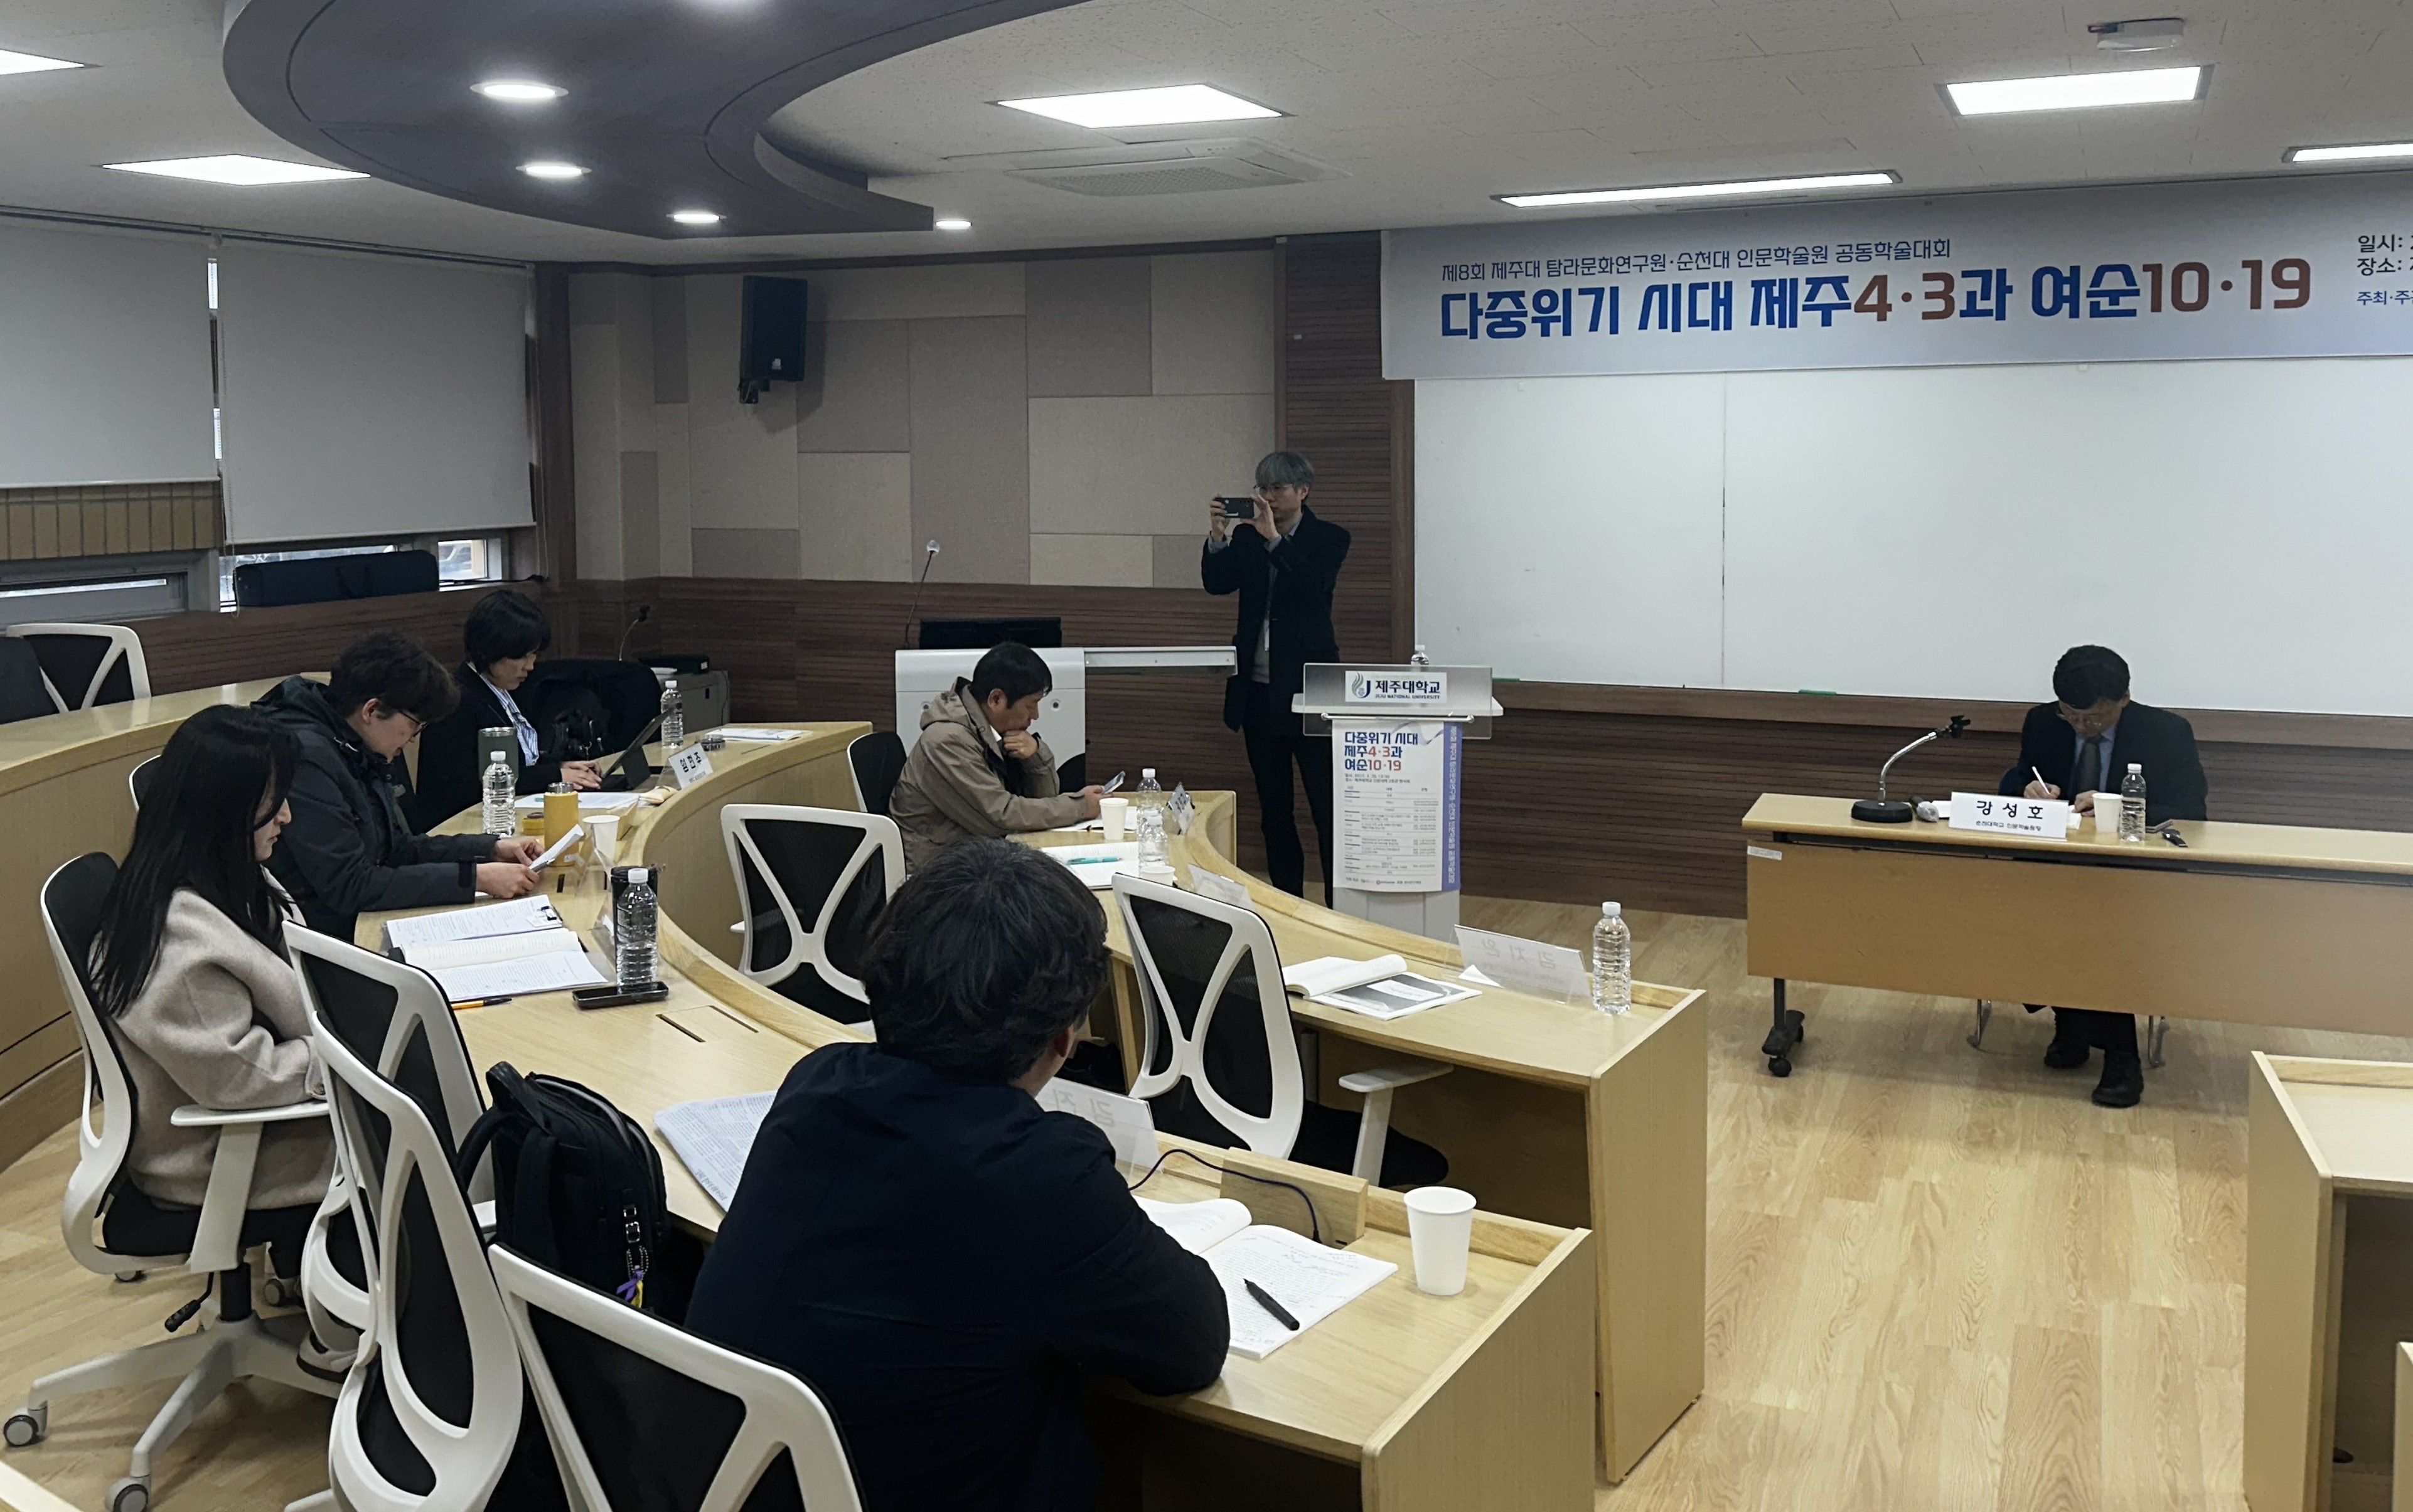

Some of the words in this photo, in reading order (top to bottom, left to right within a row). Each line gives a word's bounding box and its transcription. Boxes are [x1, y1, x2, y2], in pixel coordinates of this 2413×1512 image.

[2358, 234, 2403, 253] 일시:
[1442, 262, 1485, 282] 제8회
[1491, 260, 1540, 280] 제주대
[1546, 250, 1730, 277] 탐라문화연구원·순천대
[1736, 245, 1828, 268] 인문학술원
[1836, 238, 1950, 263] 공동학술대회
[2357, 257, 2402, 276] 장소:
[1441, 286, 1619, 339] 다중위기
[1637, 281, 1733, 333] 시대
[1750, 266, 2013, 329] 제주4·3과
[2031, 257, 2312, 319] 여순10·19
[2357, 290, 2413, 306] 주최·주
[1375, 680, 1440, 694] 제주대학교
[1344, 732, 1391, 745] 다중위기
[1395, 733, 1418, 745] 시대
[1344, 745, 1403, 758] 제주4·3과
[1344, 759, 1401, 771] 여순10·19
